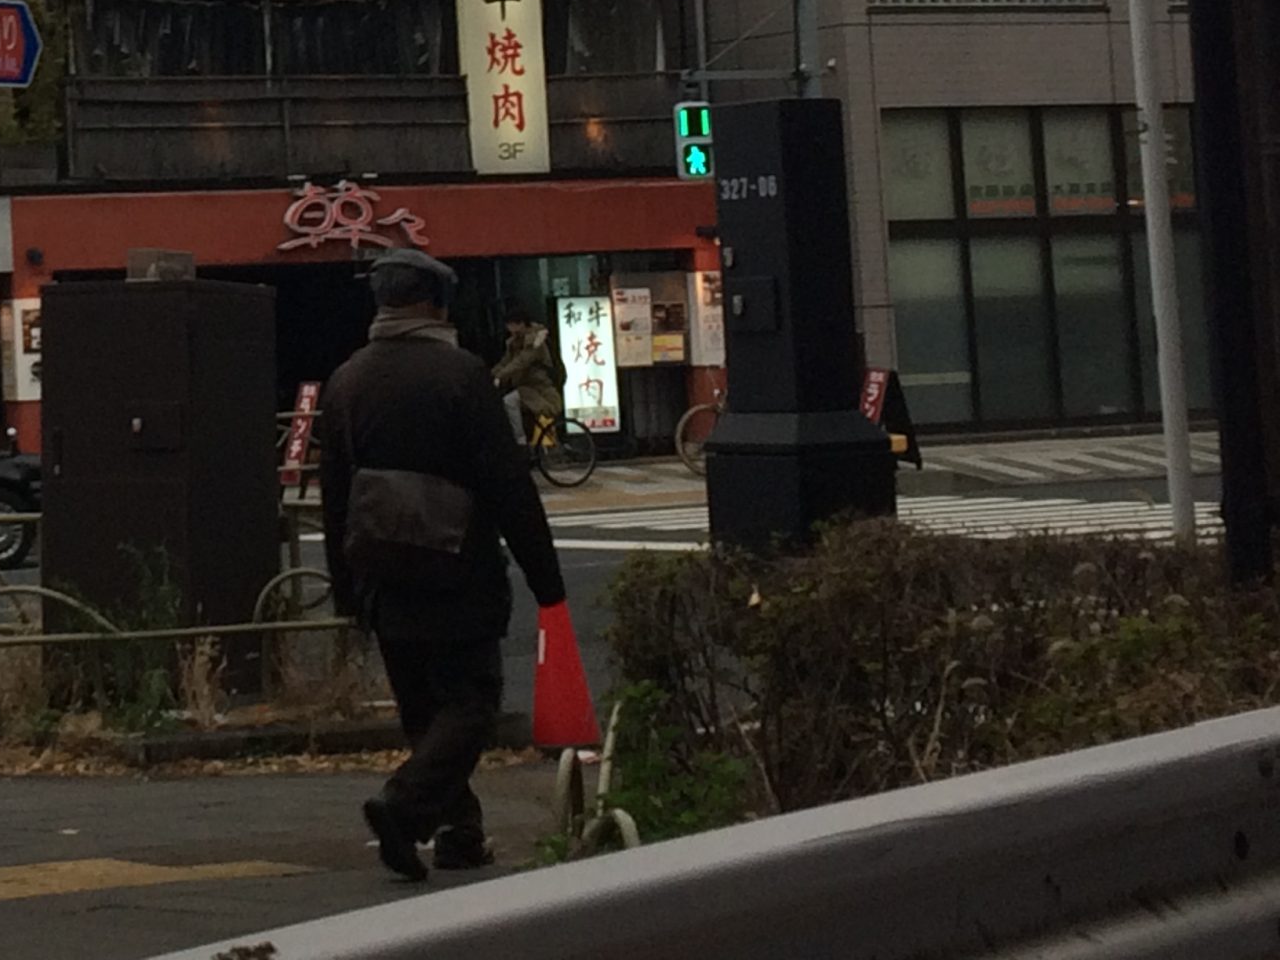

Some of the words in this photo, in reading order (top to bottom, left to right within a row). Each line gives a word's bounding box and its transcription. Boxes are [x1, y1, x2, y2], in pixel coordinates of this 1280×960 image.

[498, 142, 525, 161] 3F
[564, 300, 608, 328] 和牛
[572, 330, 606, 408] 焼肉
